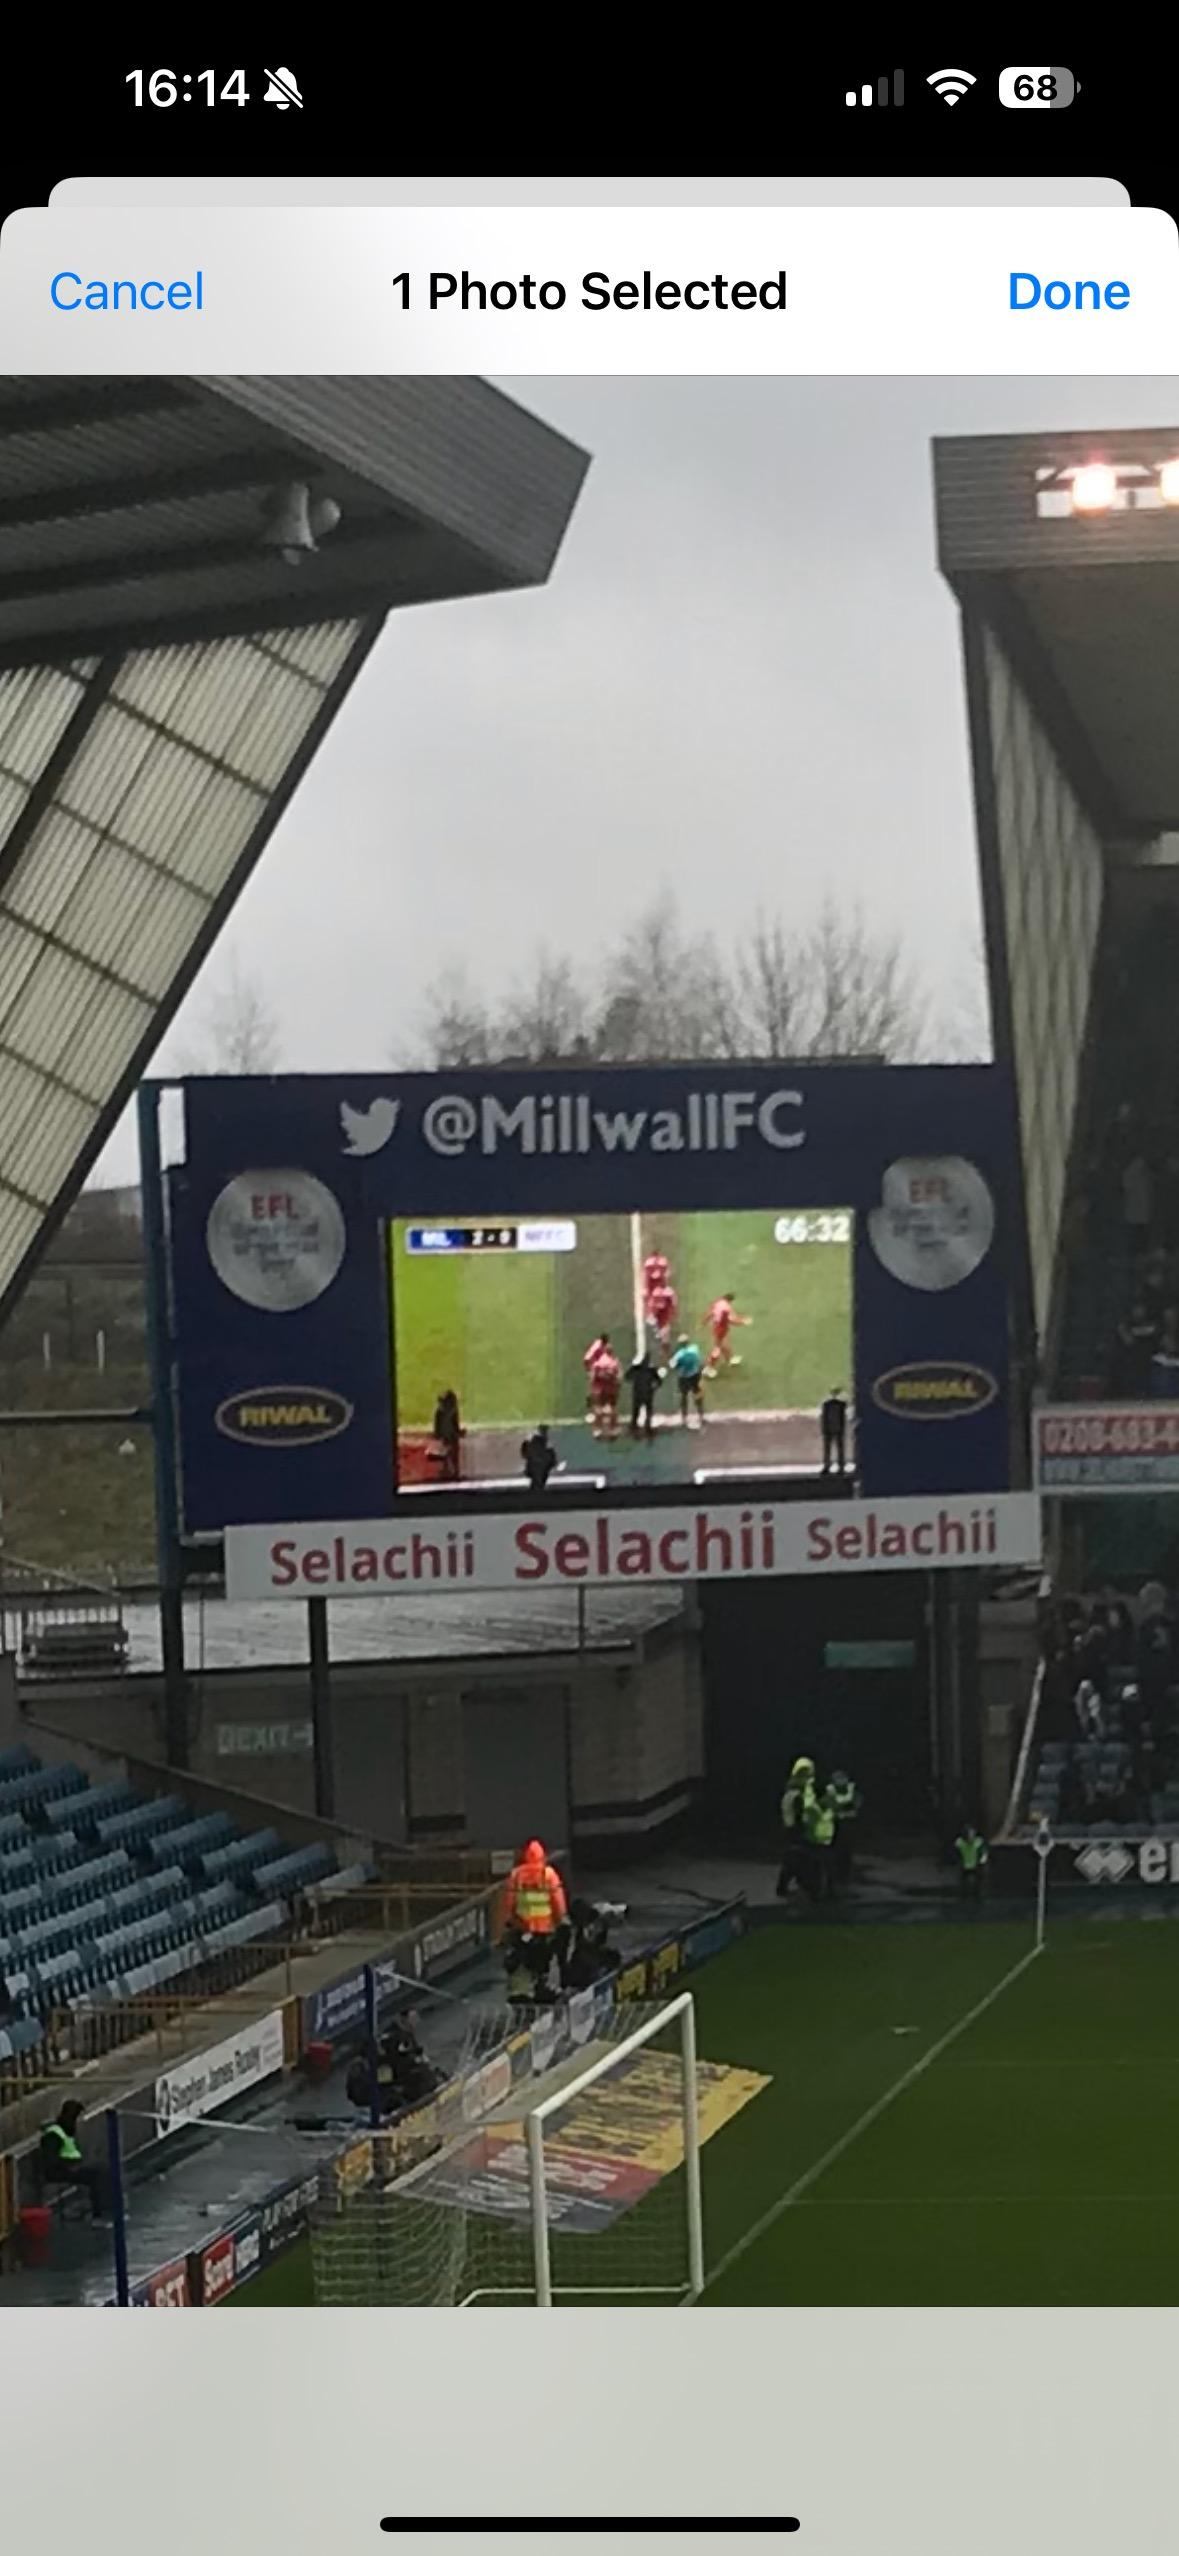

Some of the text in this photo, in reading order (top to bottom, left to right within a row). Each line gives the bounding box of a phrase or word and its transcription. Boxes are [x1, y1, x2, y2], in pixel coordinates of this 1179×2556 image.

[424, 1090, 806, 1155] @MillwallFC
[251, 1193, 299, 1220] EFL
[775, 1215, 850, 1243] 66:32
[240, 1405, 331, 1428] RIWAL
[271, 1508, 996, 1586] Selachii Selachii Selachii
